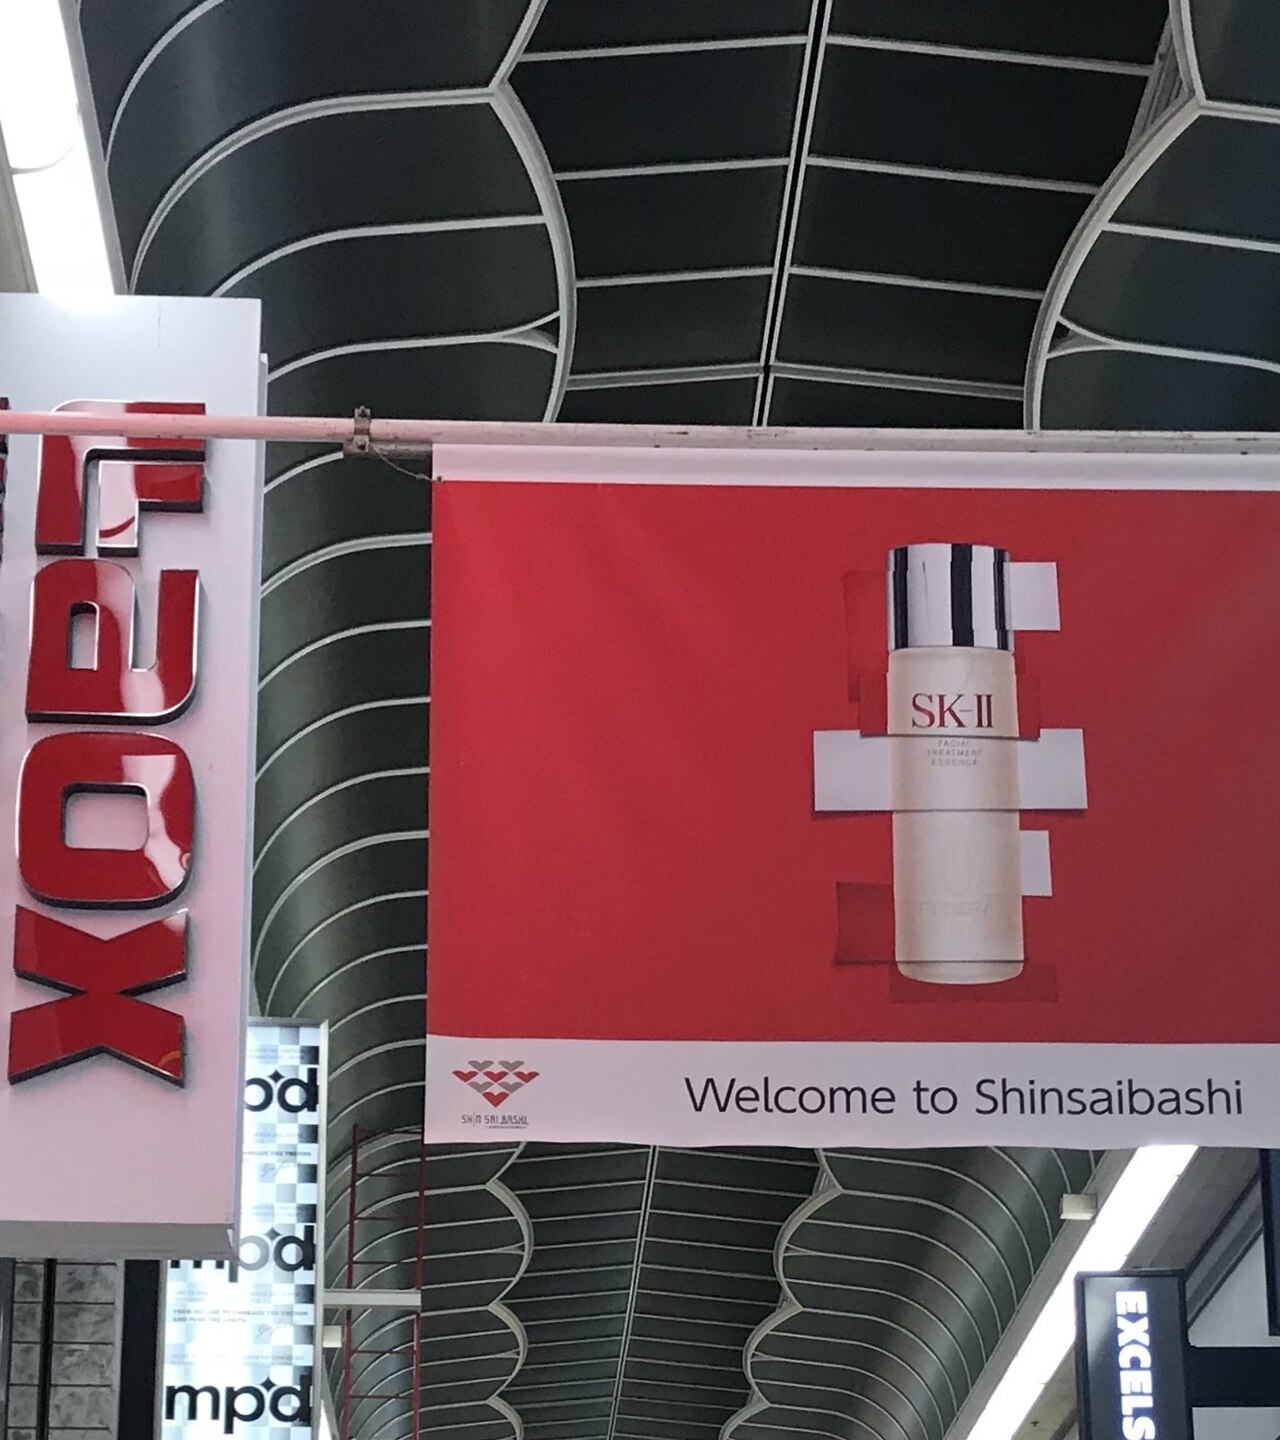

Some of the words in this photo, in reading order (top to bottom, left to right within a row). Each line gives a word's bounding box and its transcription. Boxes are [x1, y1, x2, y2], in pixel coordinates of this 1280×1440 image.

[684, 1076, 896, 1116] Welcome
[913, 1080, 958, 1116] to
[975, 1076, 1243, 1117] Shinsaibashi
